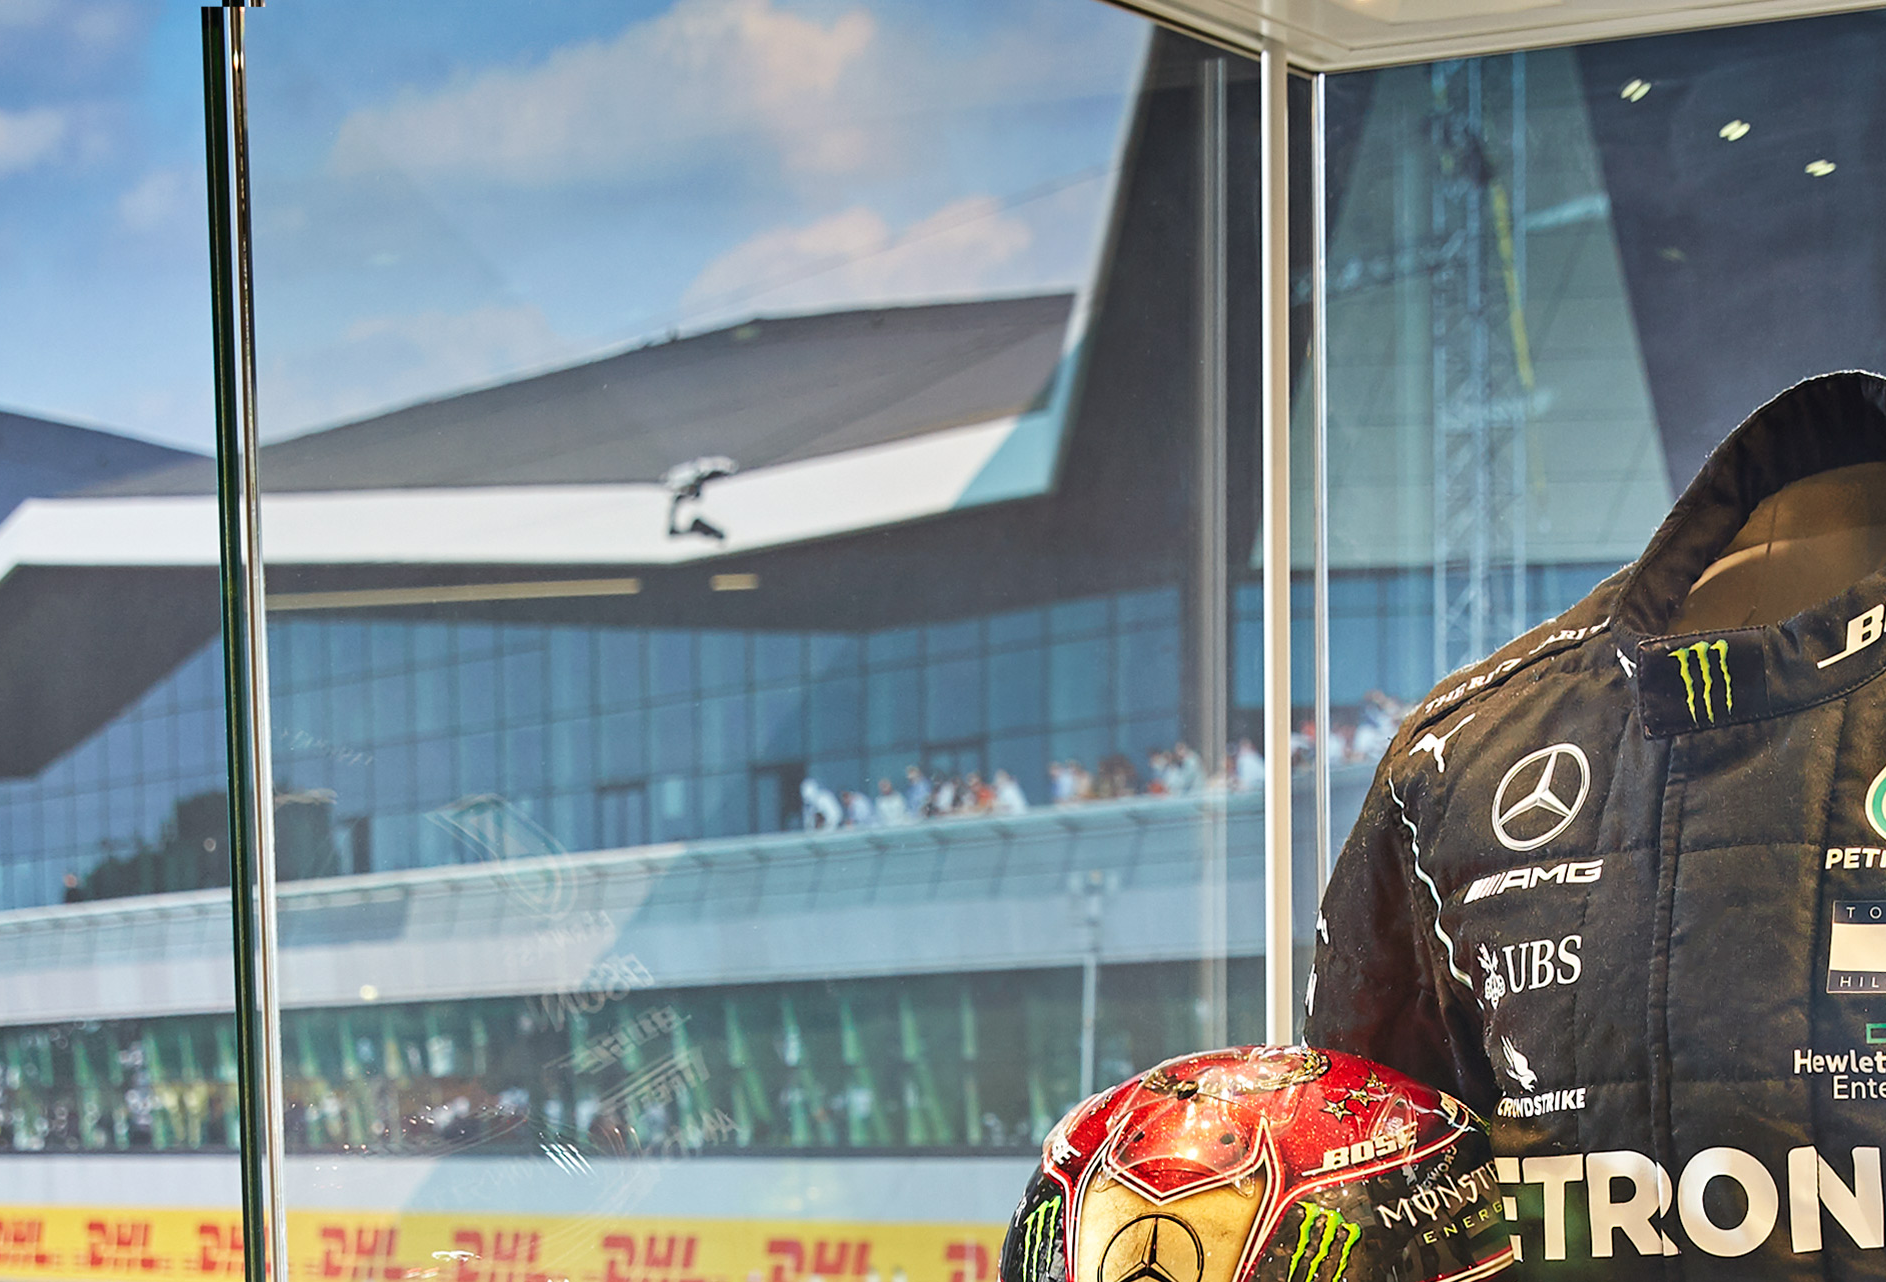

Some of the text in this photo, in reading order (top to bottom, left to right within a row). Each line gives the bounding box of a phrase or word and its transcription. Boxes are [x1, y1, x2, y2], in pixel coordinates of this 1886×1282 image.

[1500, 860, 1604, 896] AMG
[1502, 935, 1582, 994] UBS
[1302, 1121, 1417, 1177] BOSE
[86, 1221, 156, 1270] DHL
[320, 1226, 405, 1280] DHL
[1422, 1200, 1503, 1245] ENERG
